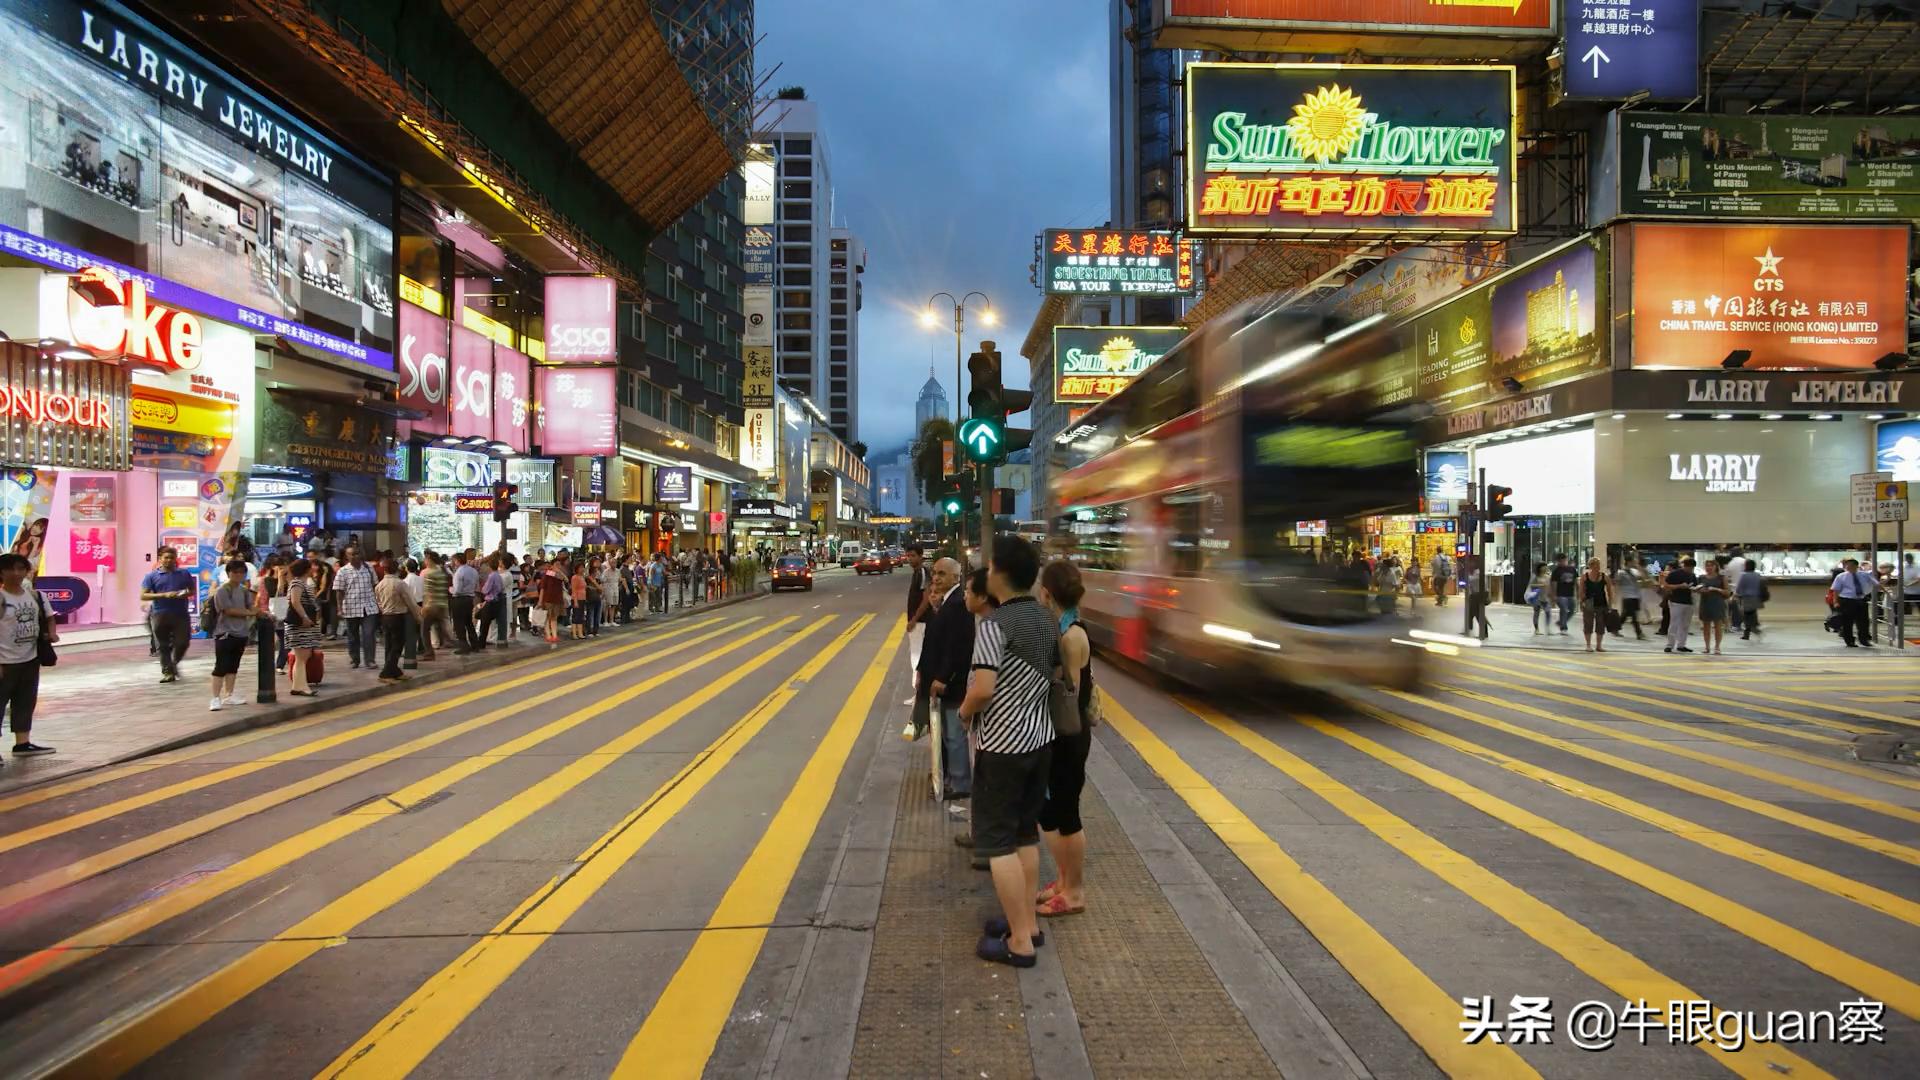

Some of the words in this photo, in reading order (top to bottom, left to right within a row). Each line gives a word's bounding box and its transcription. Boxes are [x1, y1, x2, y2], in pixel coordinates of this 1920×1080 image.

[1582, 8, 1655, 21] 九龍酒店一樓
[1582, 23, 1655, 35] 卓越理財中心
[81, 9, 209, 111] LARRY
[219, 95, 334, 184] JEWELRY
[1636, 122, 1676, 131] Guangzhou
[1206, 110, 1506, 166] Sunflower
[1736, 164, 1773, 172] Mountain
[1867, 162, 1890, 170] World
[1891, 163, 1912, 171] Expo
[1723, 171, 1747, 179] Panyu
[1877, 170, 1914, 178] Shanghai
[1054, 266, 1128, 281] SHOESTRING
[1129, 267, 1173, 282] TRAVEL
[1053, 281, 1077, 291] VISA
[1080, 282, 1110, 291] TOUR
[1753, 278, 1784, 292] CTS
[1671, 300, 1696, 315] 香港
[1817, 301, 1869, 317] 有限公司
[1659, 320, 1690, 331] CHINA
[1691, 320, 1729, 332] TRAVEL
[1729, 321, 1771, 332] SERVICE
[1772, 321, 1805, 334] (HONG
[1806, 321, 1839, 334] KONG)
[1840, 322, 1879, 332] LIMITED
[550, 323, 611, 348] Sasa
[1419, 358, 1449, 376] LEADING
[1688, 379, 1770, 402] LARRY
[1791, 380, 1904, 403] JEWELRY
[1448, 411, 1485, 435] LARRY
[1493, 393, 1552, 425] JEWELRY
[1670, 454, 1760, 480] LARRY
[1706, 481, 1756, 492] JEWELRY
[574, 505, 598, 513] SONY
[1883, 509, 1905, 520] 全日
